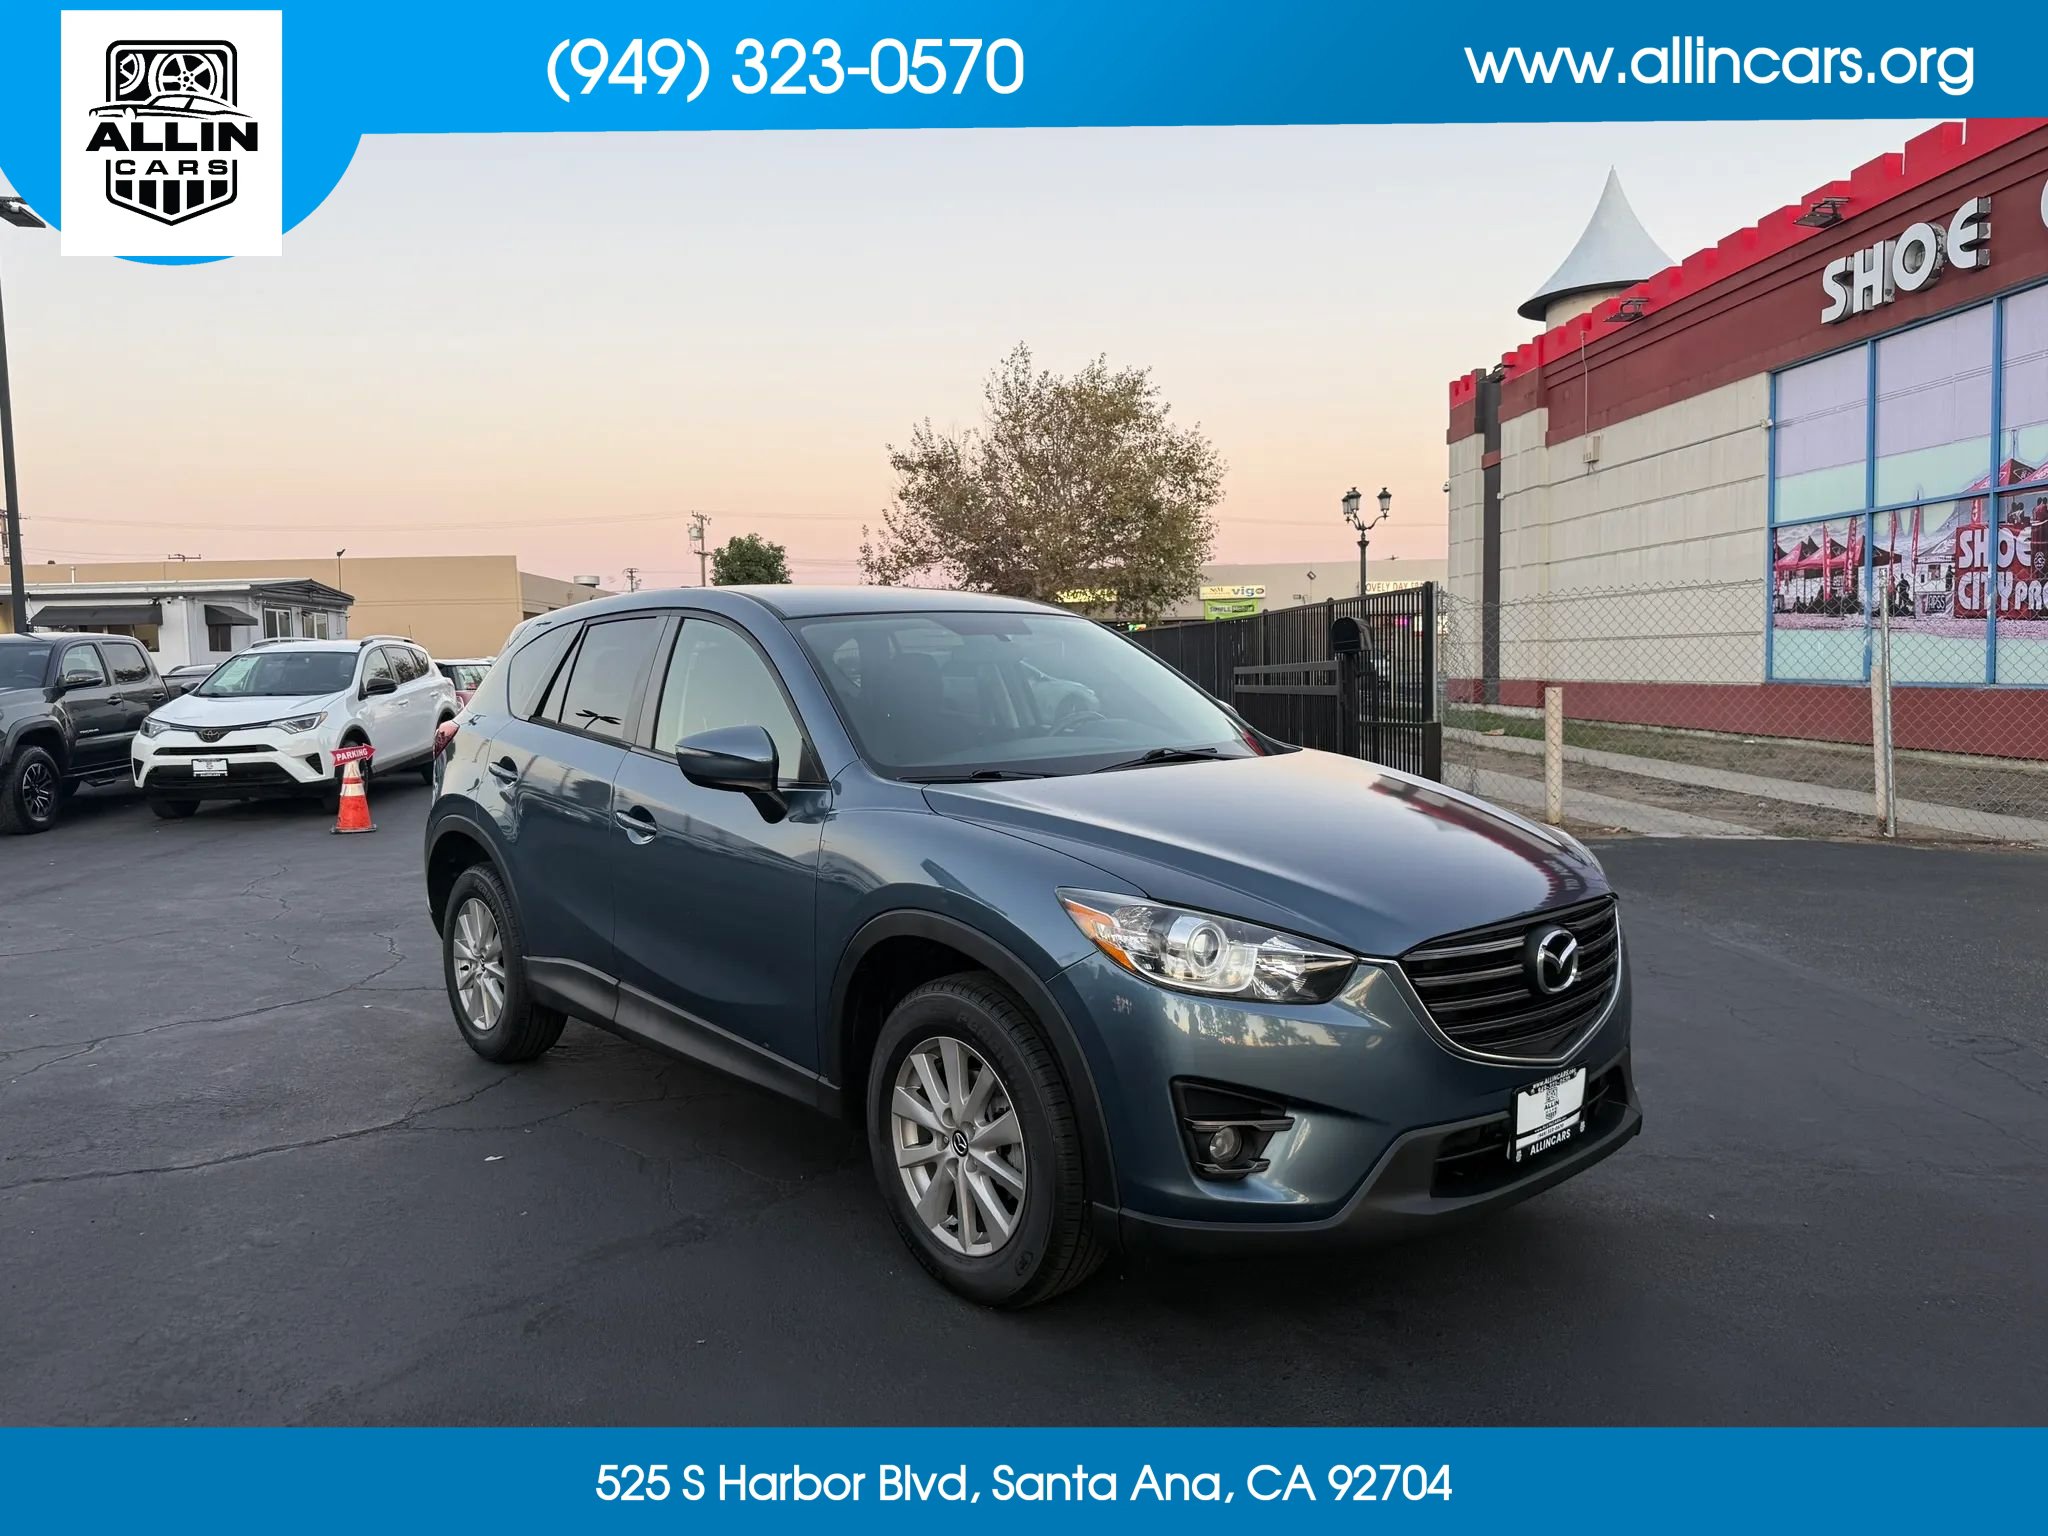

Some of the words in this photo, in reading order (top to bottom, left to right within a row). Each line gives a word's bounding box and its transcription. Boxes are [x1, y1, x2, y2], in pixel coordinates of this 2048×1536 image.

[1821, 196, 1990, 323] SHOE
[1959, 526, 2031, 568] SHOE
[1232, 586, 1264, 597] vigo
[1366, 582, 1390, 592] OVELY
[336, 748, 368, 761] PARKING
[1530, 1128, 1572, 1156] ALLINCARS
